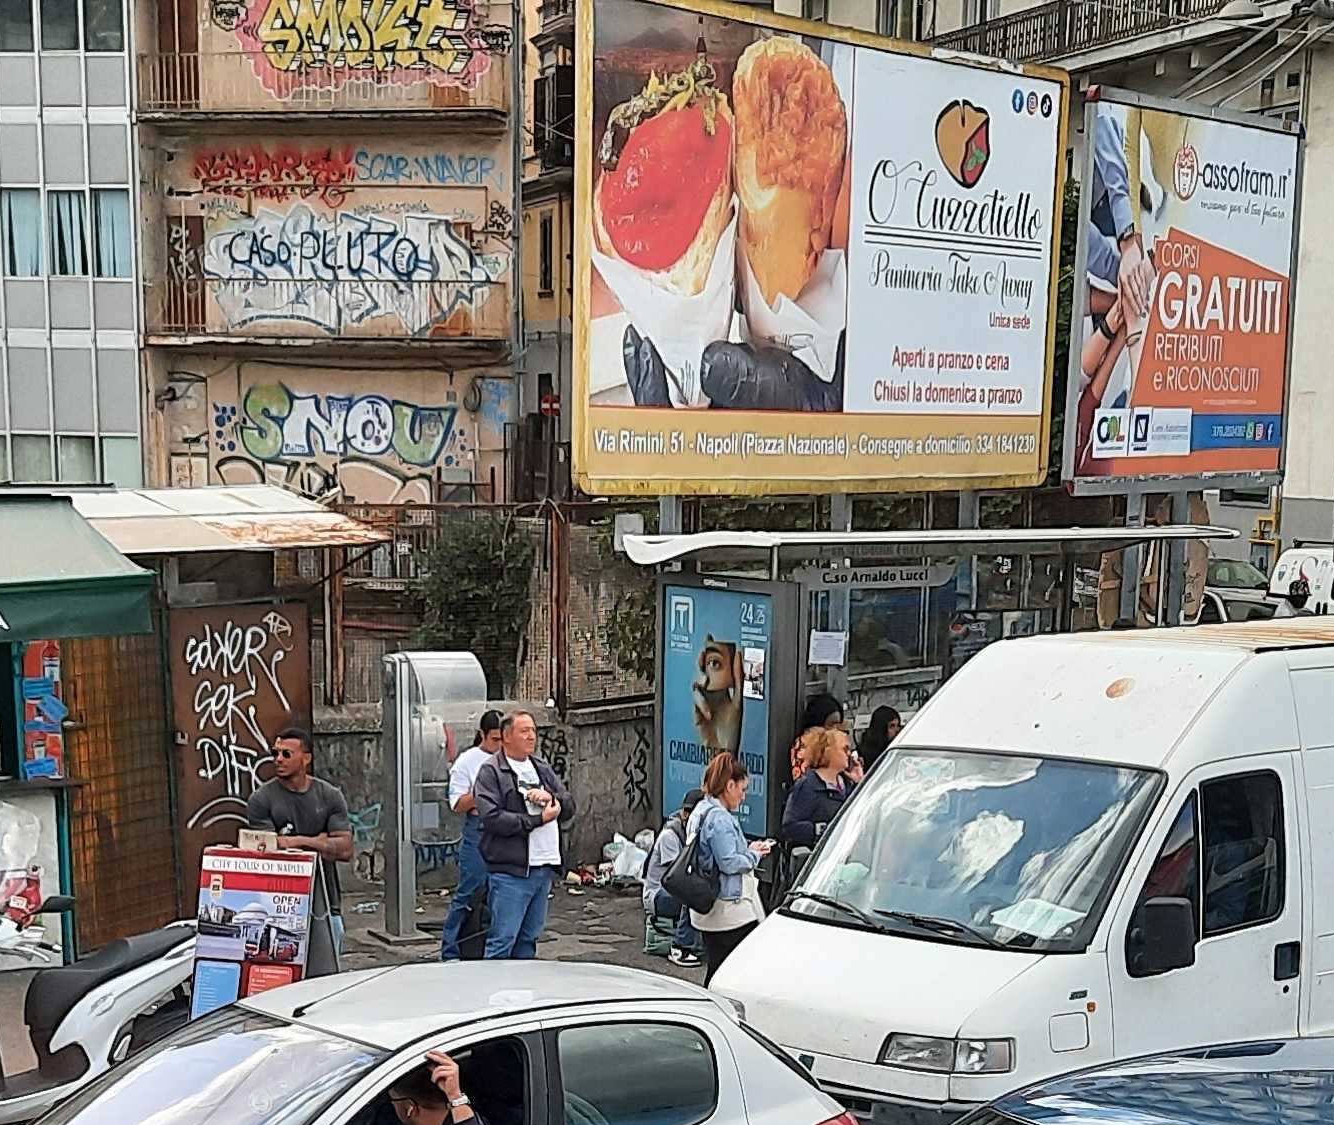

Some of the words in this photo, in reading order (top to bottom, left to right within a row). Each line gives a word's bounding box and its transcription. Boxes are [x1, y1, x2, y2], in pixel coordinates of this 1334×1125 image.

[1161, 241, 1200, 269] CORSI
[1158, 271, 1283, 334] GRATUITI
[989, 312, 1011, 328] Unica
[1012, 314, 1031, 330] sede
[892, 346, 926, 372] Aperti
[928, 353, 934, 368] a
[937, 351, 974, 374] pranzo
[976, 354, 982, 369] e
[985, 353, 1010, 371] cena
[1153, 370, 1163, 391] e
[1166, 366, 1259, 392] RICONOSCIUTI
[874, 380, 910, 402] Chiusi
[913, 381, 922, 402] la
[925, 382, 977, 404] domenica
[979, 388, 985, 403] a
[987, 388, 1022, 408] pranzo
[594, 429, 616, 452] Via
[620, 430, 667, 456] Rimini,
[670, 431, 684, 453] 51
[696, 432, 738, 458] Napoli
[741, 432, 784, 459] (Piazza
[787, 433, 849, 459] Nazionale)
[859, 434, 913, 460] Consegne
[916, 439, 922, 454] a
[821, 571, 849, 584] C.so
[851, 570, 898, 583] Arnaldo
[900, 568, 929, 582] Lucci
[211, 858, 232, 870] CITY
[233, 860, 261, 872] TOUR
[262, 860, 275, 872] OF
[272, 894, 302, 906] OPEN
[275, 905, 297, 915] BUS
